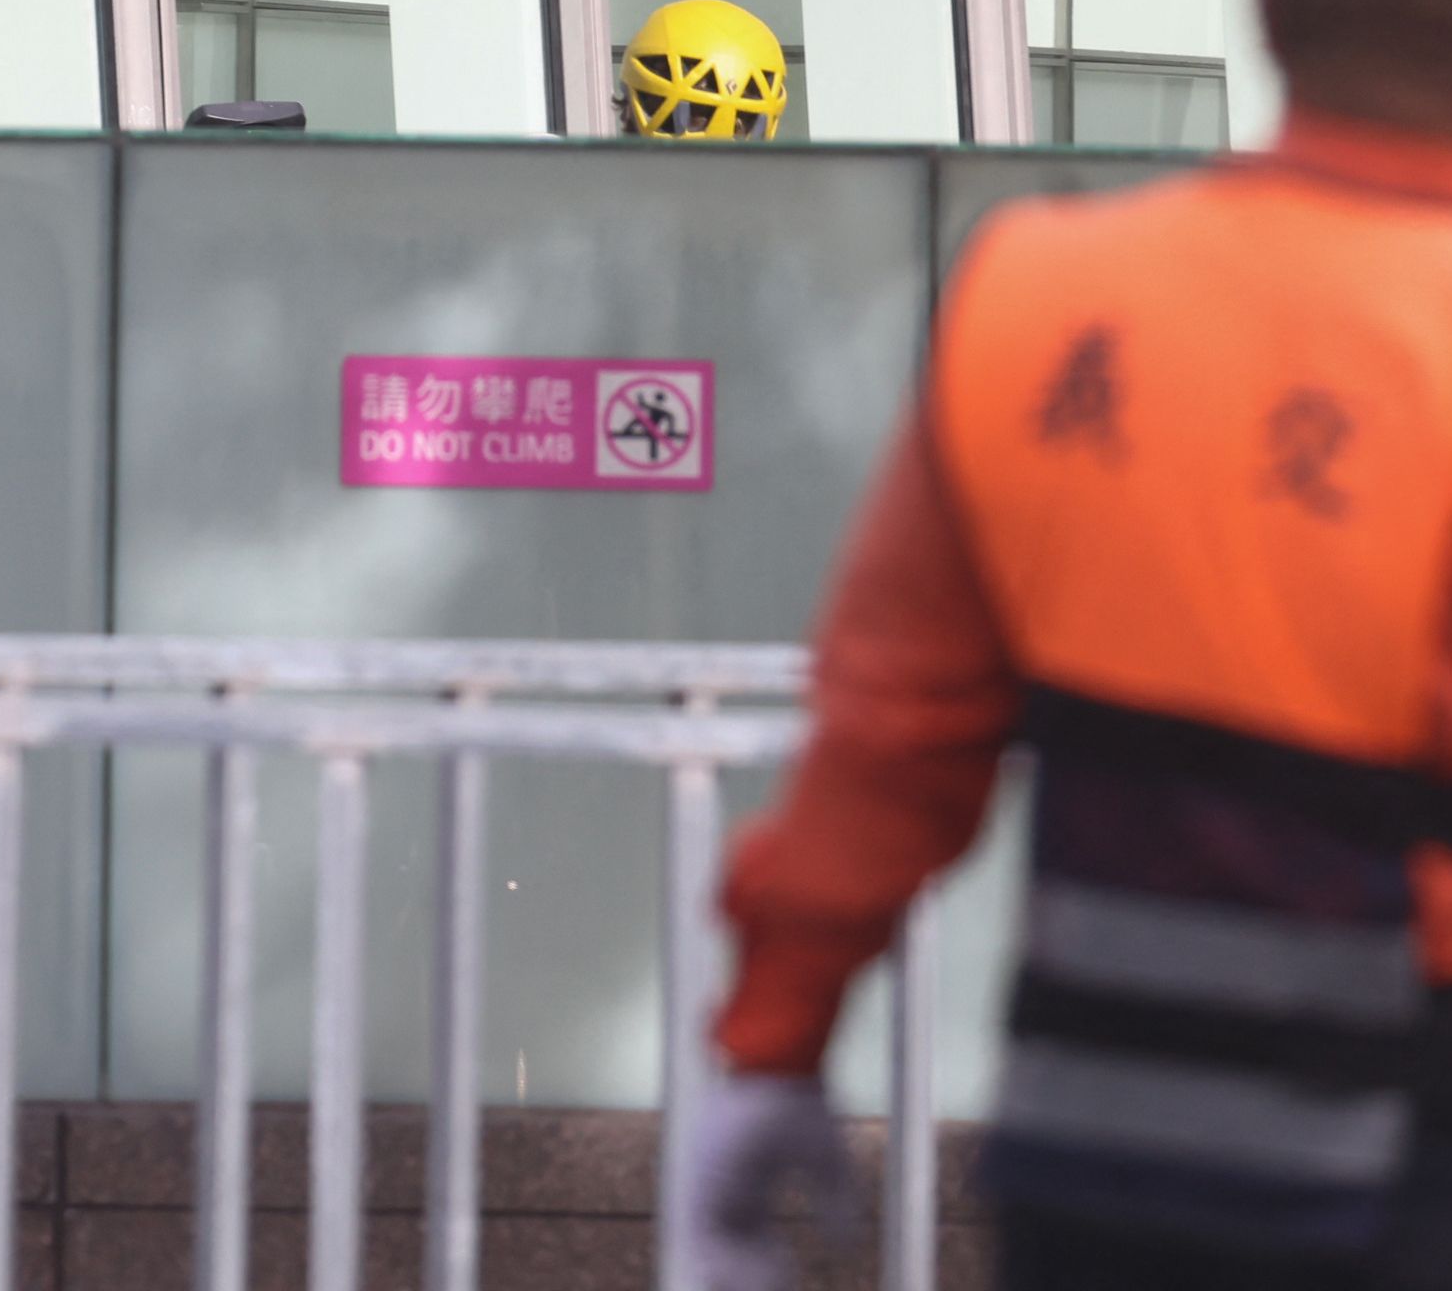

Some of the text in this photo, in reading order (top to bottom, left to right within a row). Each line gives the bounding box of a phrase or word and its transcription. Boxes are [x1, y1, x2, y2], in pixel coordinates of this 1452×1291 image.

[361, 373, 573, 425] 請勿攀爬
[360, 430, 575, 465] DO NOT CLIMB
